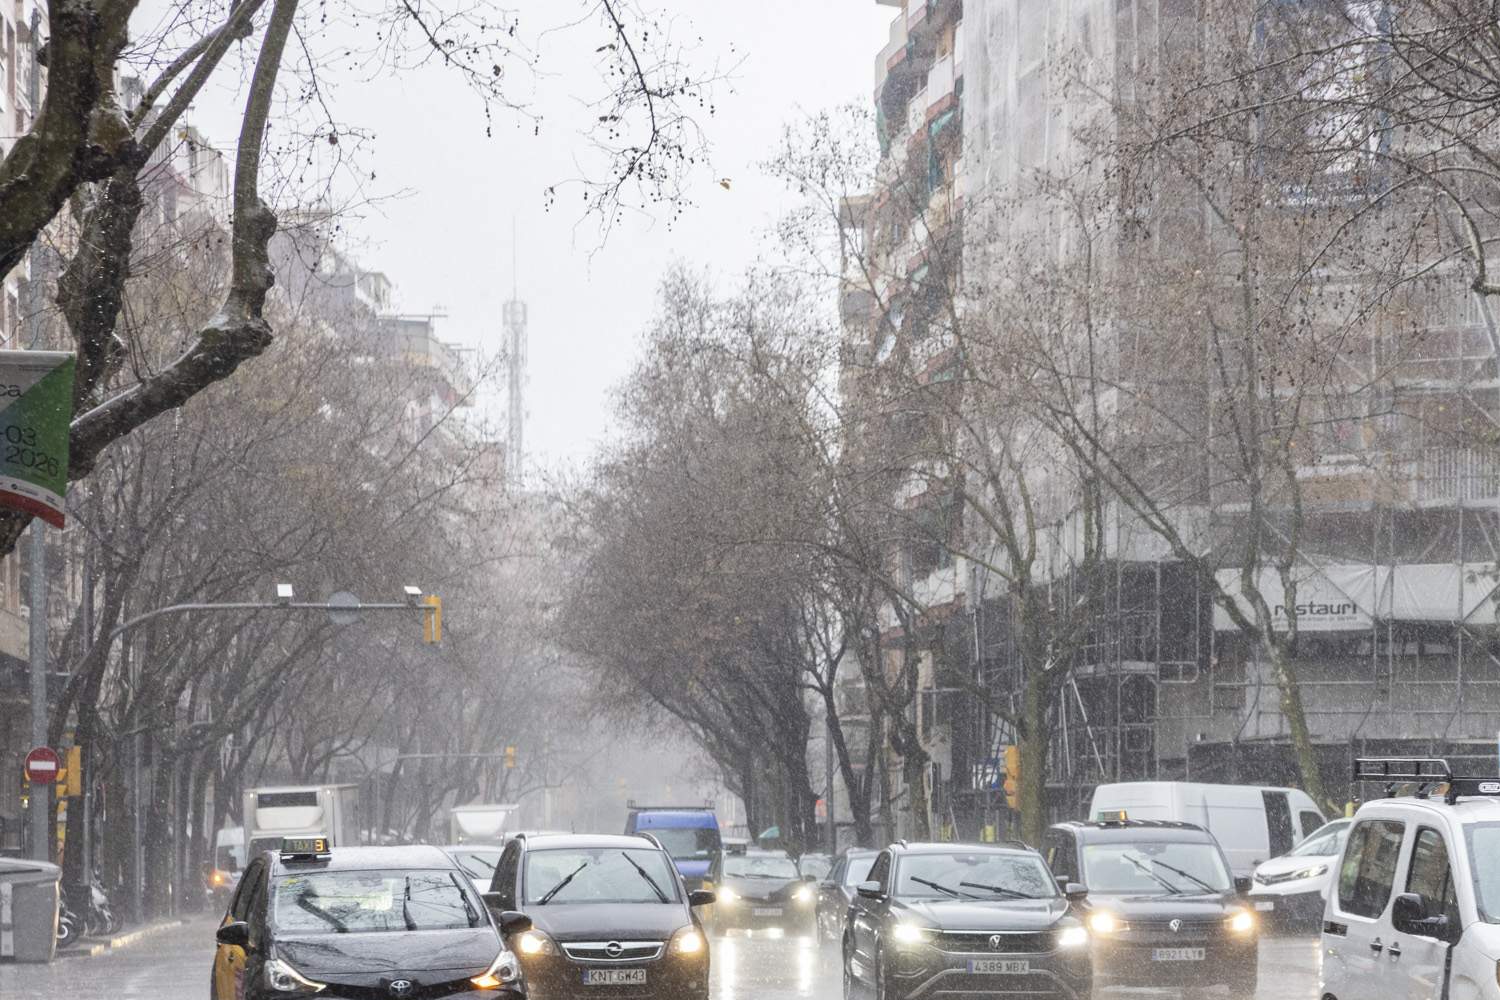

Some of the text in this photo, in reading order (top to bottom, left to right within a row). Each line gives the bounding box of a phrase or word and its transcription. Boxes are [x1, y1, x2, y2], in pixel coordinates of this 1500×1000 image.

[6, 445, 60, 477] 2026
[1274, 601, 1358, 616] rstauri
[975, 961, 1002, 971] 4389
